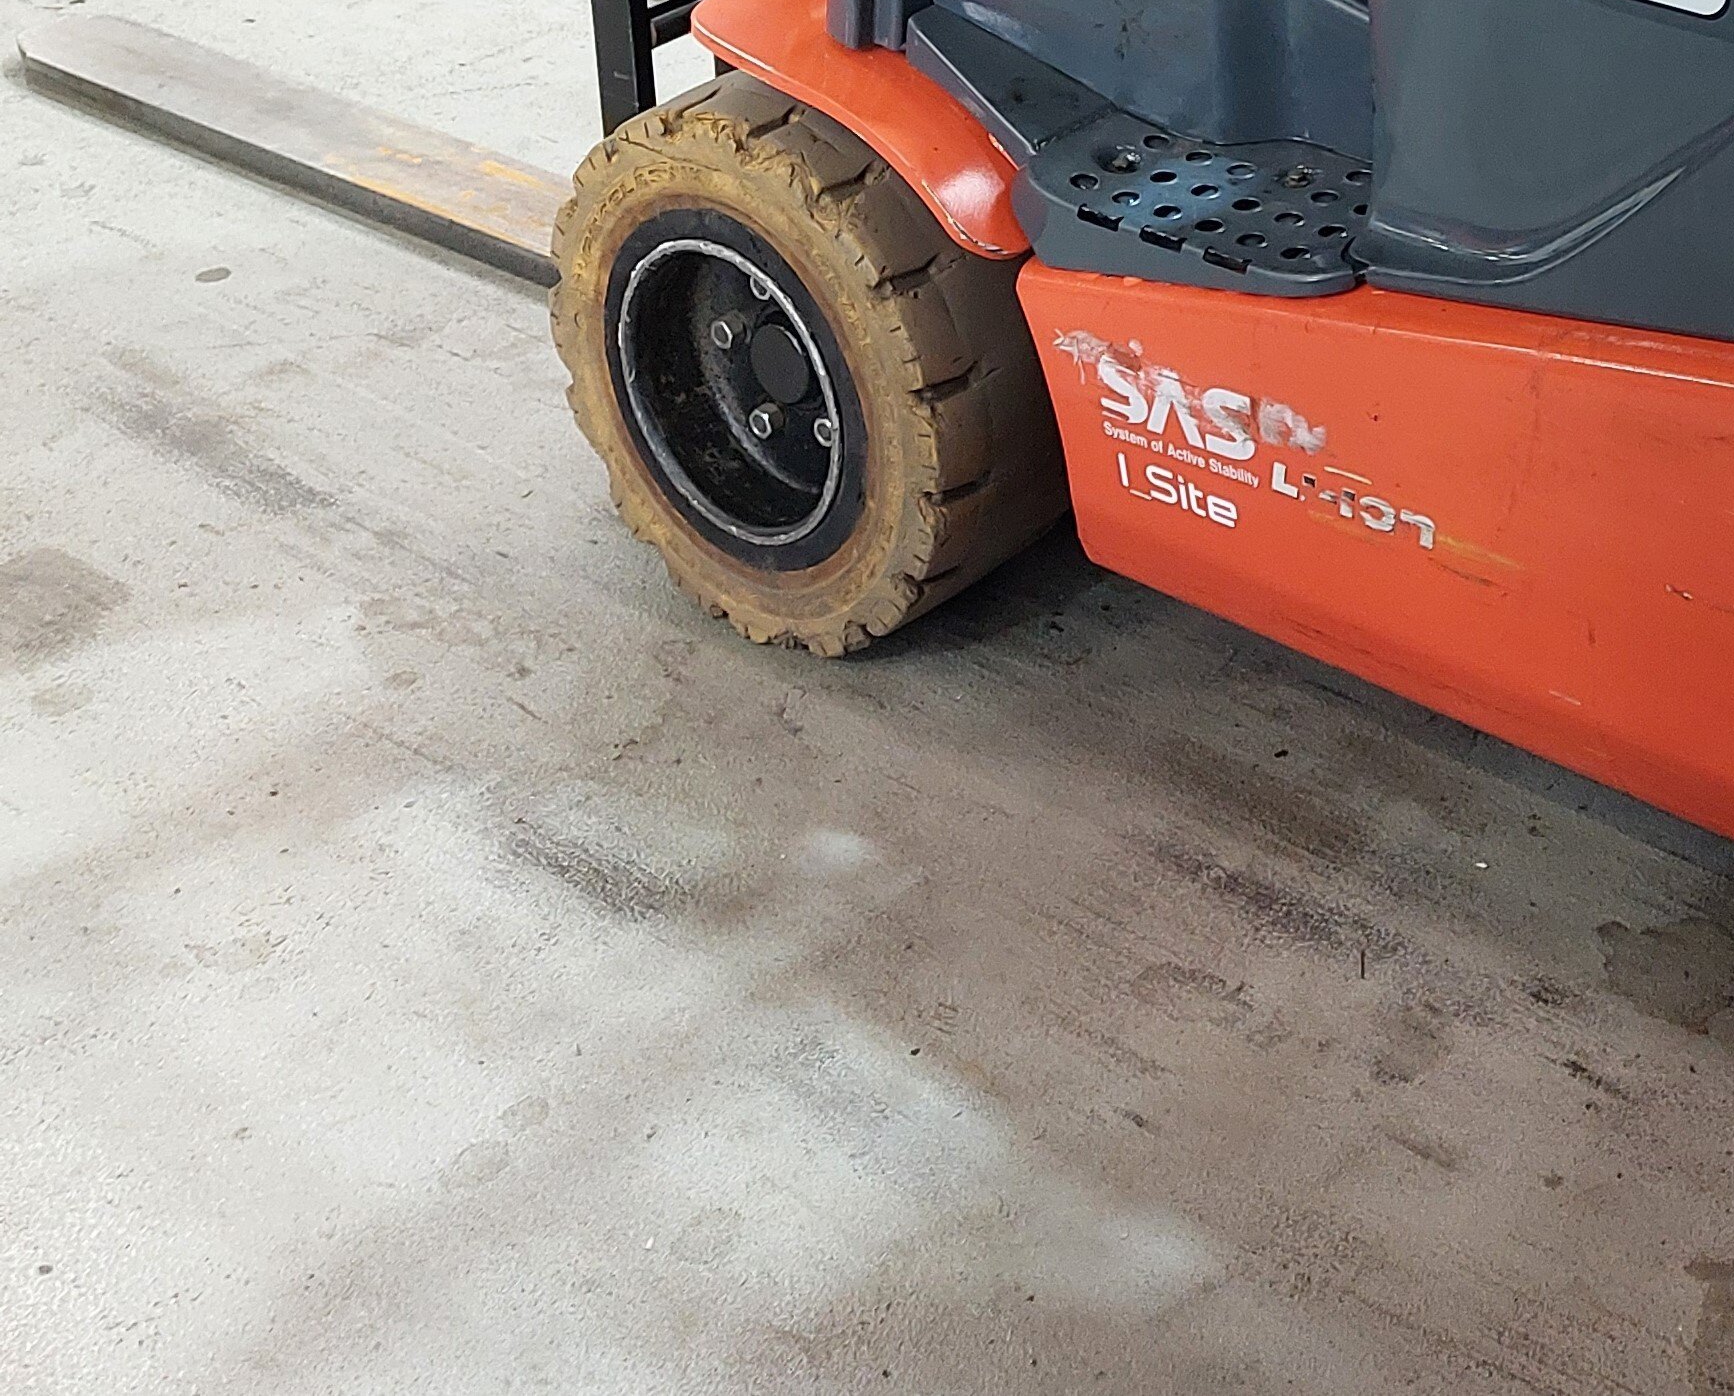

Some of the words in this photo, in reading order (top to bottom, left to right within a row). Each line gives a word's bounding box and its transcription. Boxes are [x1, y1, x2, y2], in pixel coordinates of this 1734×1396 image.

[1097, 355, 1256, 461] SAS
[1103, 421, 1149, 450] System
[1150, 439, 1164, 455] of
[1166, 442, 1207, 470] Active
[1208, 457, 1260, 490] Stability
